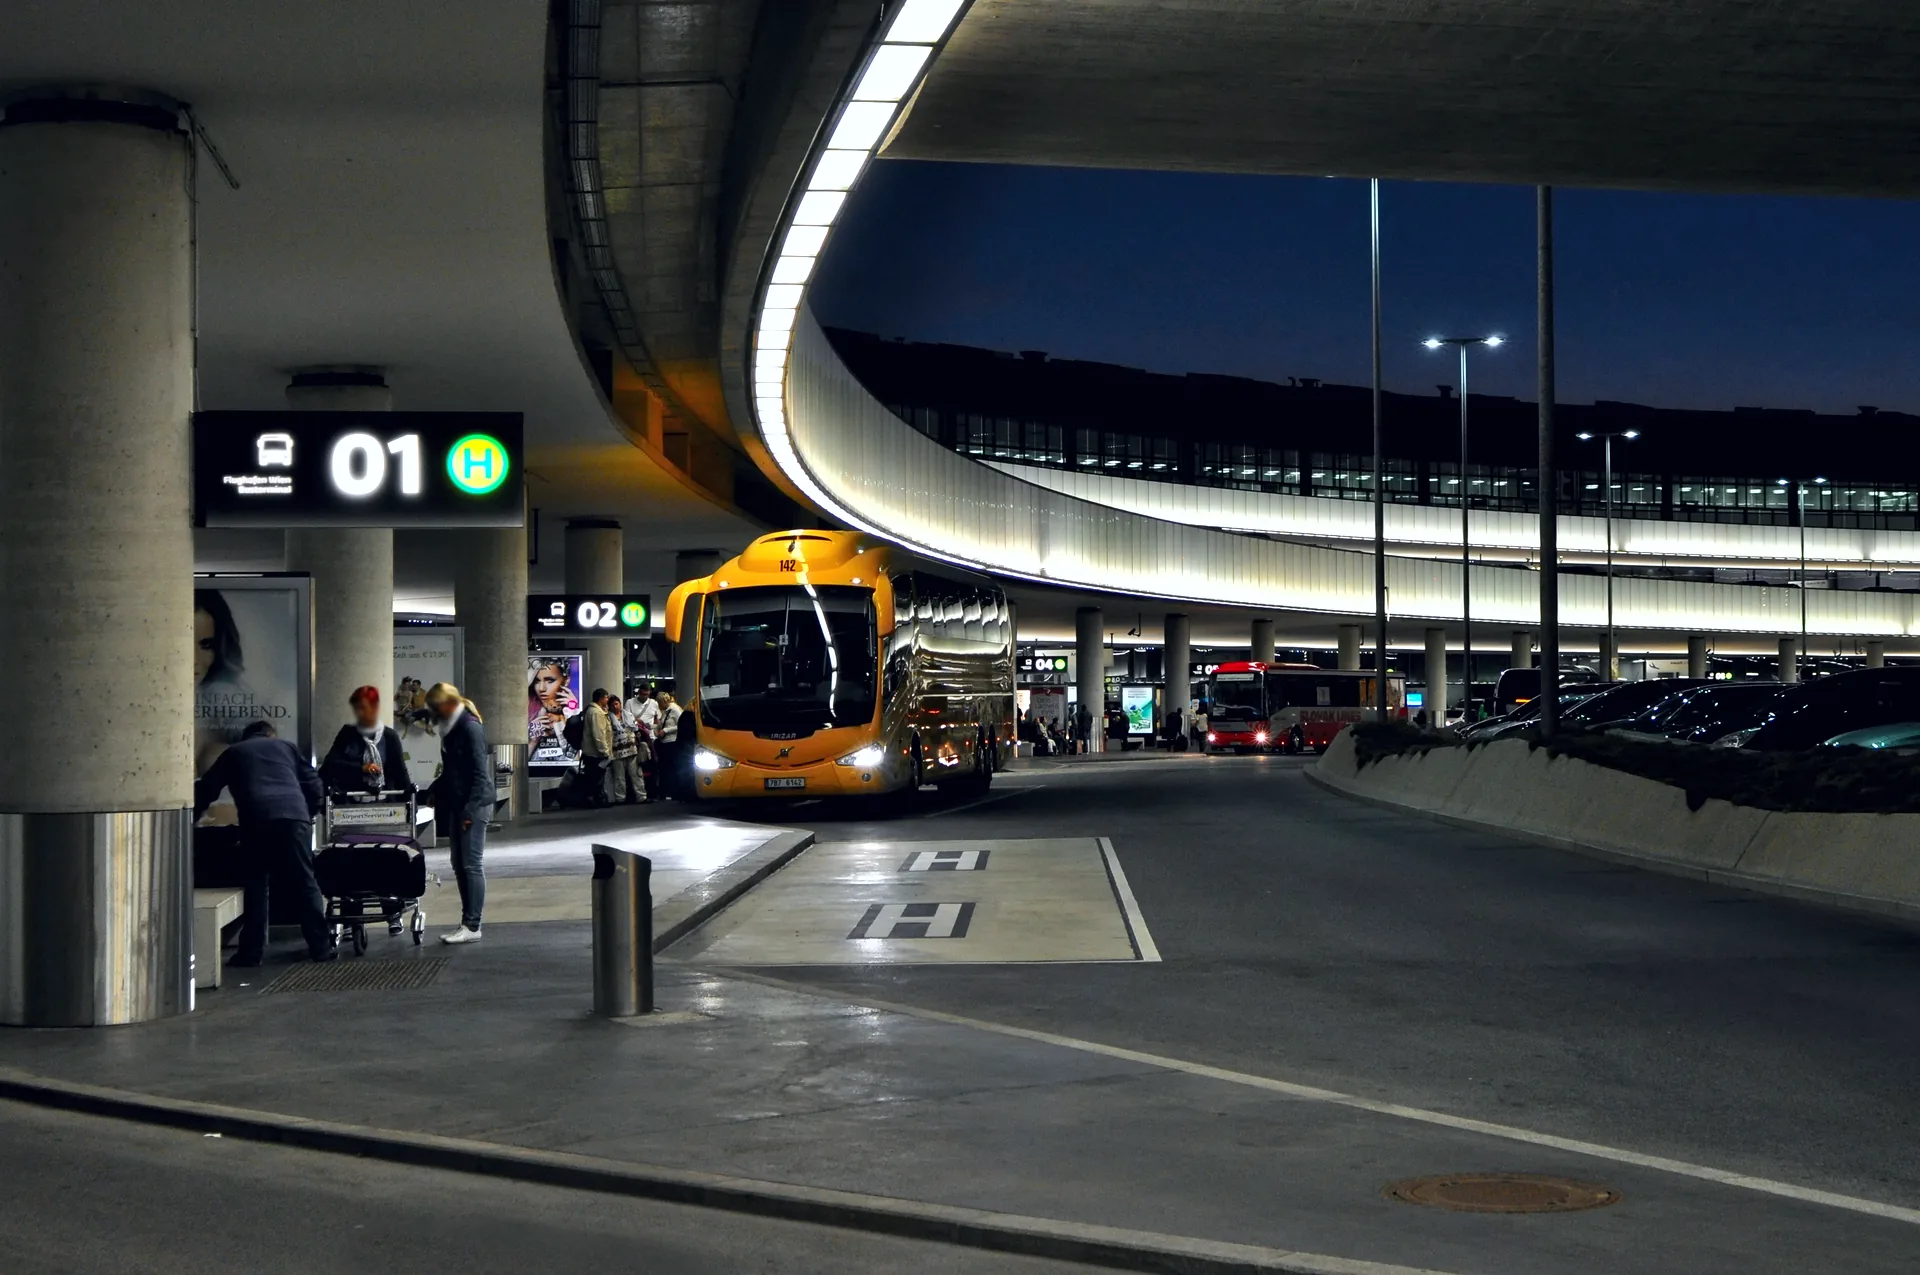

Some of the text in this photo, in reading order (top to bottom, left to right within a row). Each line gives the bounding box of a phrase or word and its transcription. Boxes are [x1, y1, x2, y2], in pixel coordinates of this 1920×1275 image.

[332, 433, 420, 495] 01
[464, 448, 492, 479] H
[223, 475, 292, 485] Flughafen Wien
[780, 559, 796, 572] 142
[578, 602, 617, 628] 02
[1035, 658, 1055, 671] 04
[1300, 710, 1361, 722] SLOVAK LINES
[770, 732, 797, 740] IRIZAR
